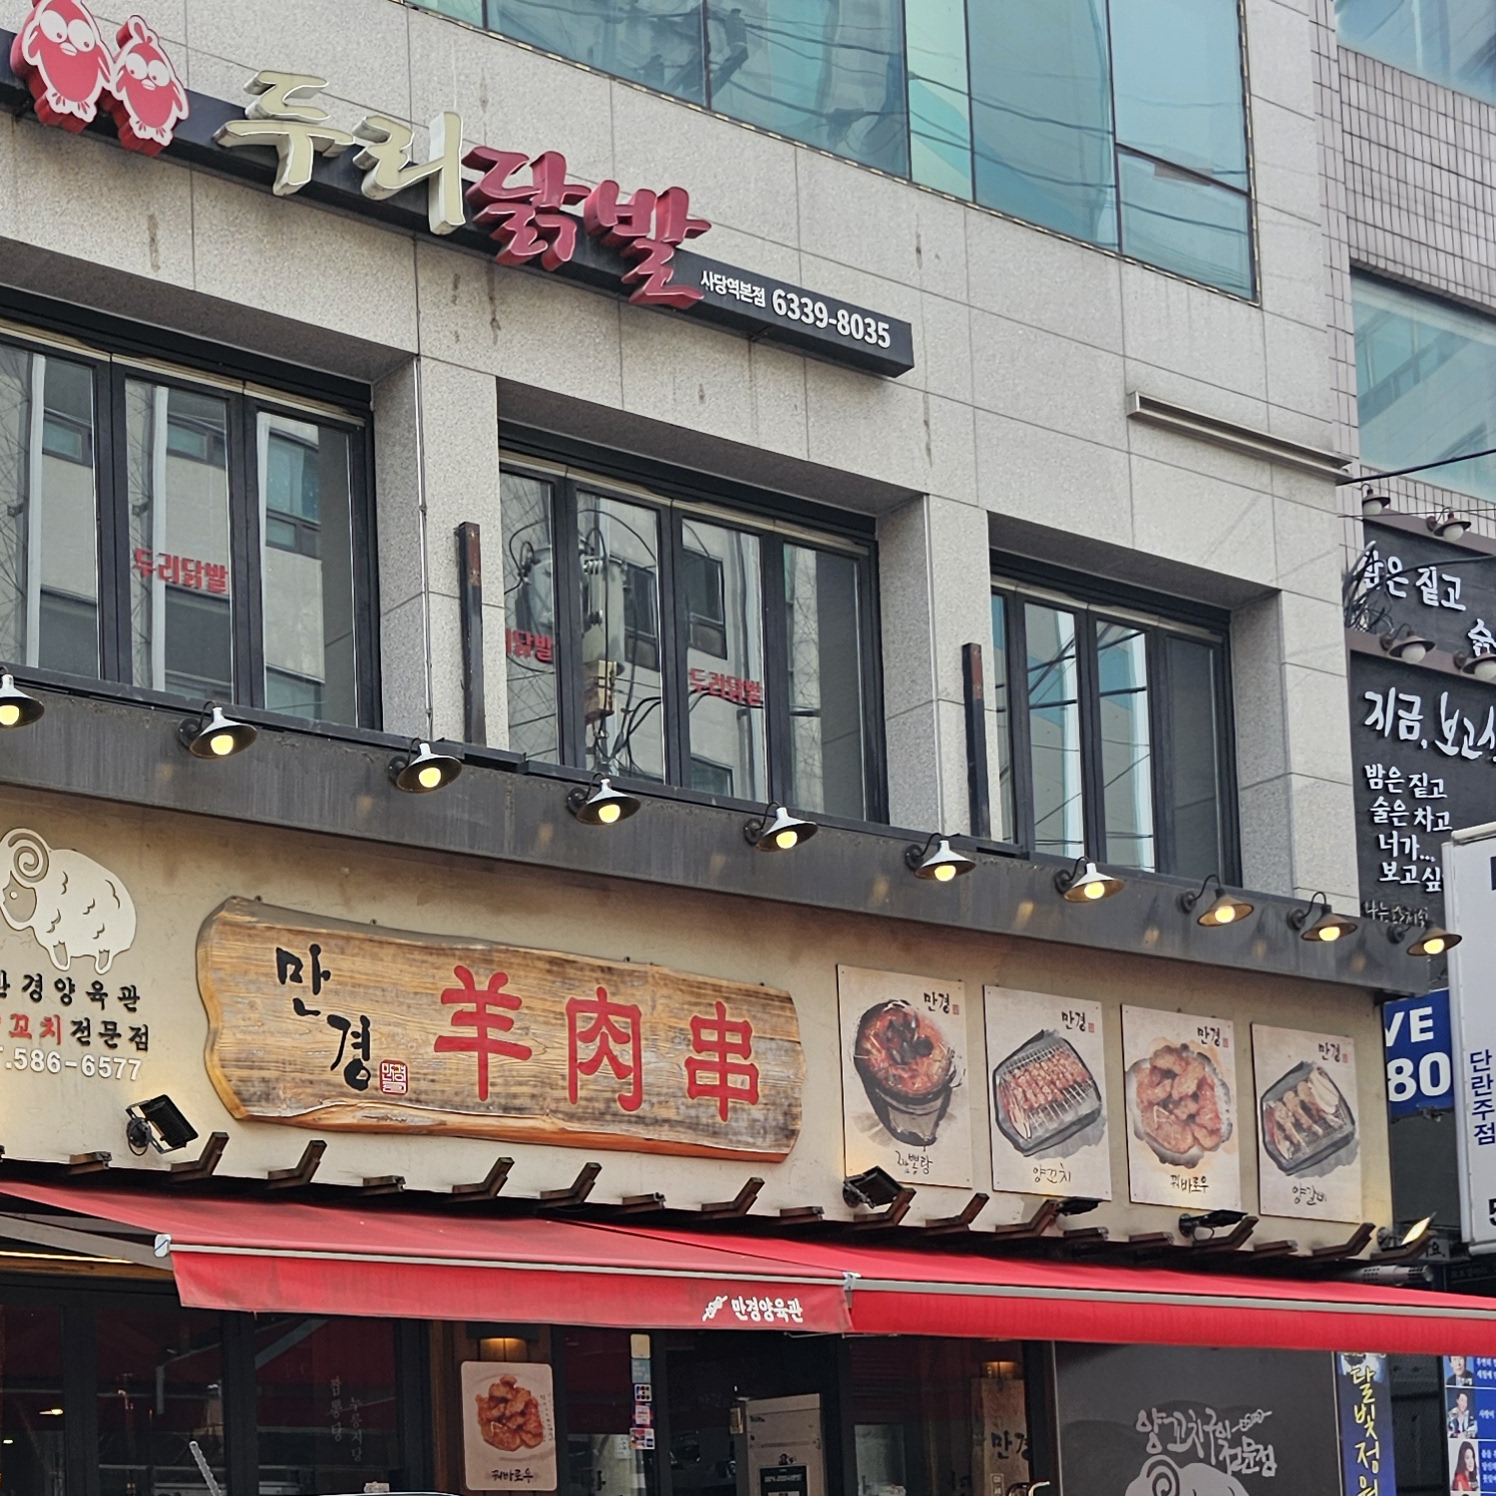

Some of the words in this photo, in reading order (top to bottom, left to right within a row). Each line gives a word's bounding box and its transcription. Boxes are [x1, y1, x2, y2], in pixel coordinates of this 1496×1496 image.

[700, 270, 767, 308] 사당역본점
[772, 288, 892, 348] 6339-8035
[132, 547, 230, 594] 두리닭발
[1415, 565, 1467, 611] 짙고
[688, 667, 763, 706] 두리닭발
[1364, 686, 1429, 750] 지금,
[1364, 763, 1405, 794] 밤은
[1408, 772, 1448, 799] 짙고
[1370, 796, 1410, 827] 술은
[1413, 805, 1453, 832] 차고
[923, 991, 951, 1015] 만경
[1061, 1011, 1087, 1032] 만경
[434, 964, 760, 1122] 羊肉串
[1197, 1026, 1221, 1047] 만경
[1318, 1042, 1341, 1063] 만경
[1469, 1048, 1496, 1145] 단란주점
[731, 1296, 804, 1323] 만경양육관
